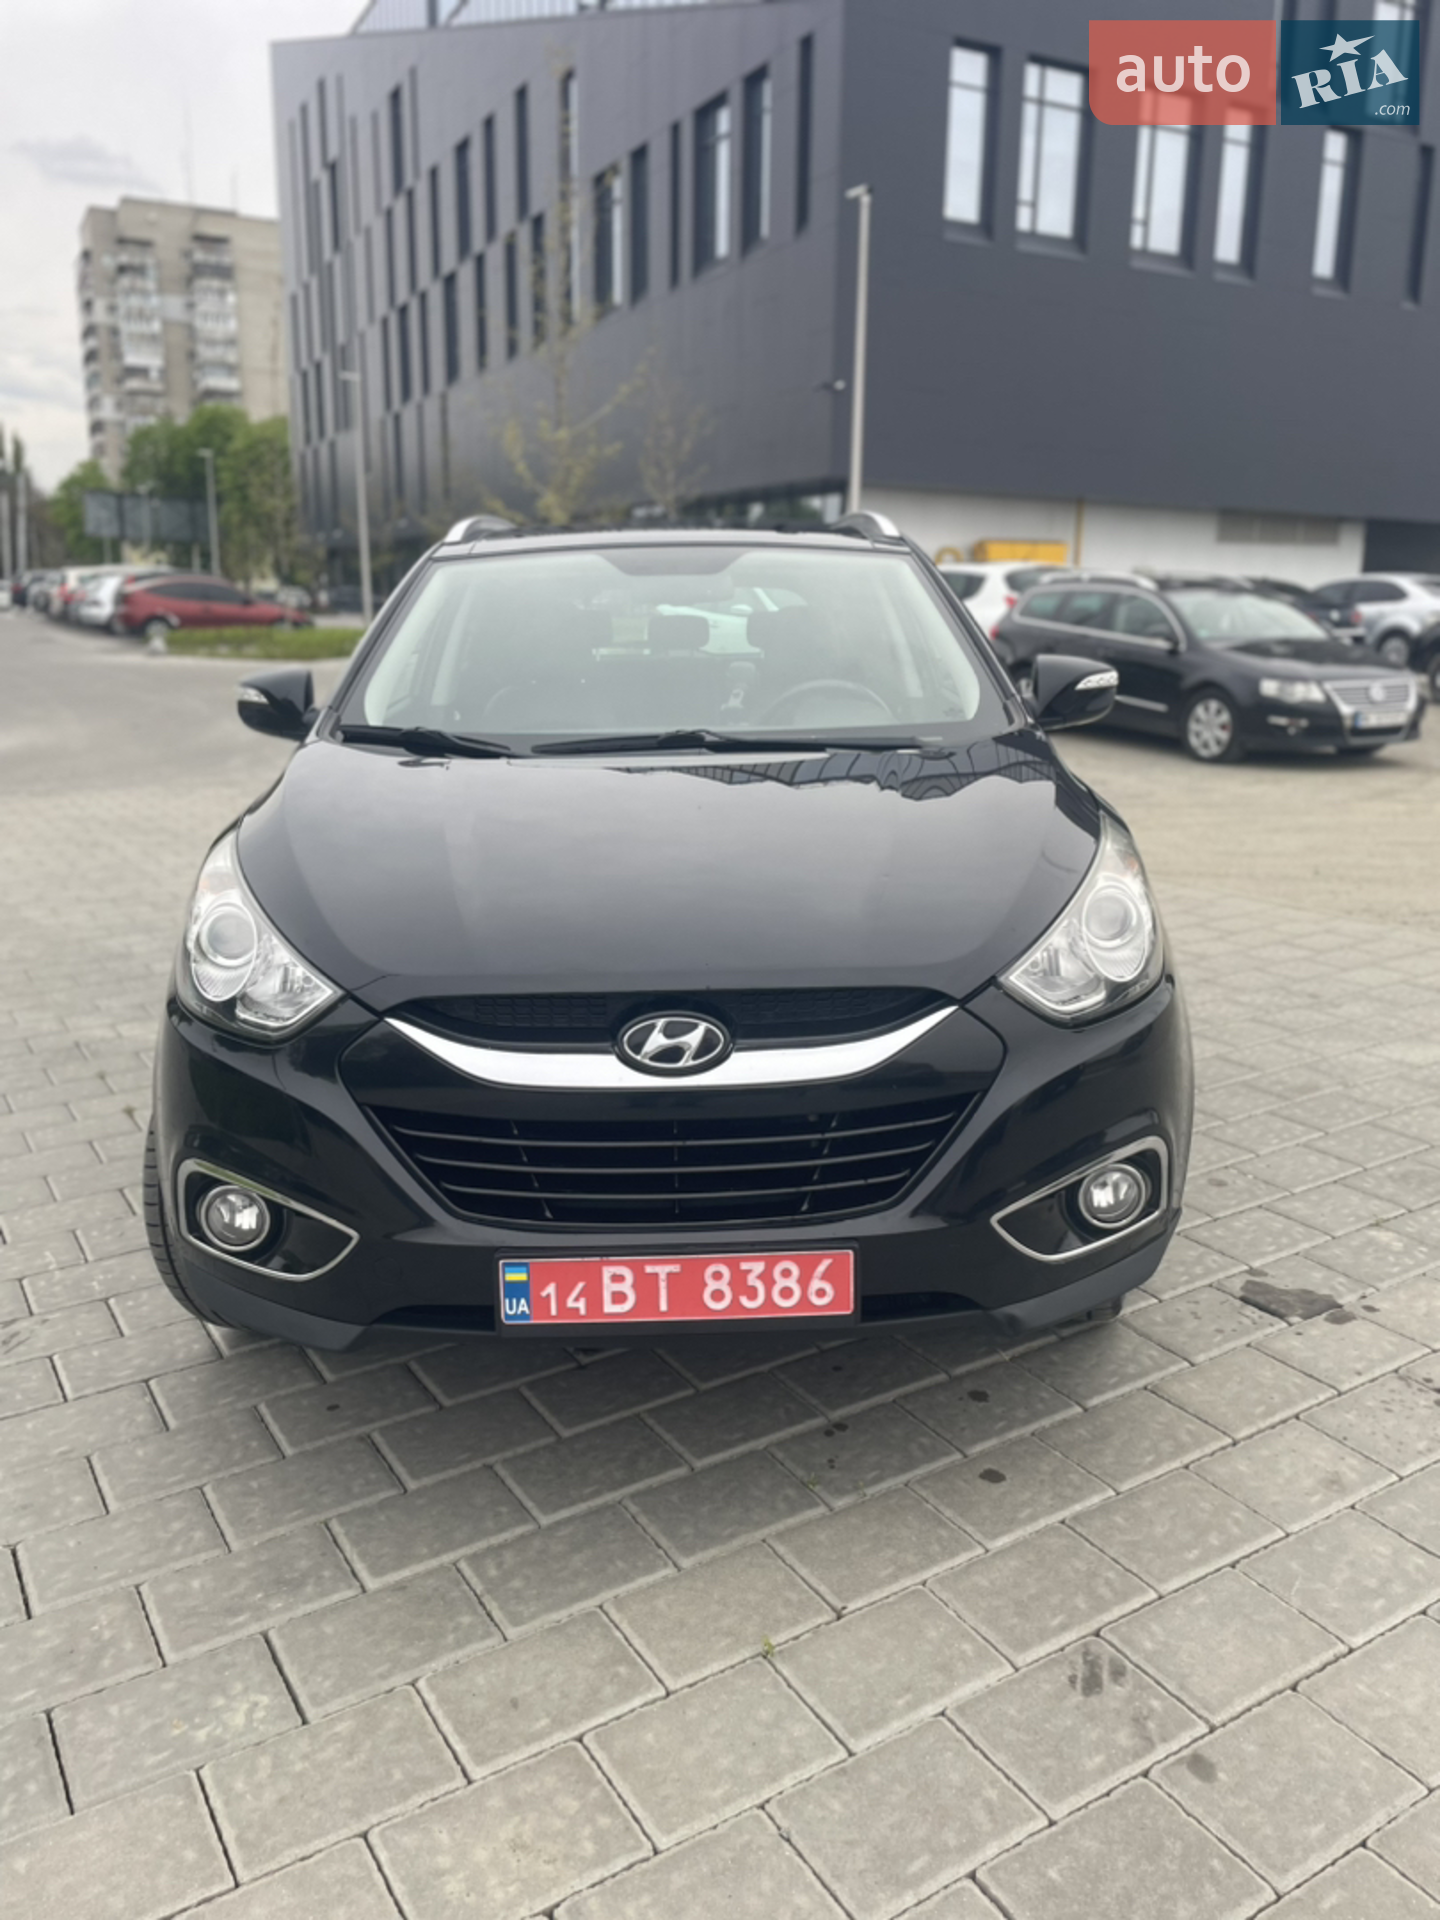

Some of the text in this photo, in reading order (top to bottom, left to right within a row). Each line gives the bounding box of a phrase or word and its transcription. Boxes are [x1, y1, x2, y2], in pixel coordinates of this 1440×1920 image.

[540, 1259, 835, 1316] 14 BT 8386
[505, 1298, 530, 1316] UA
